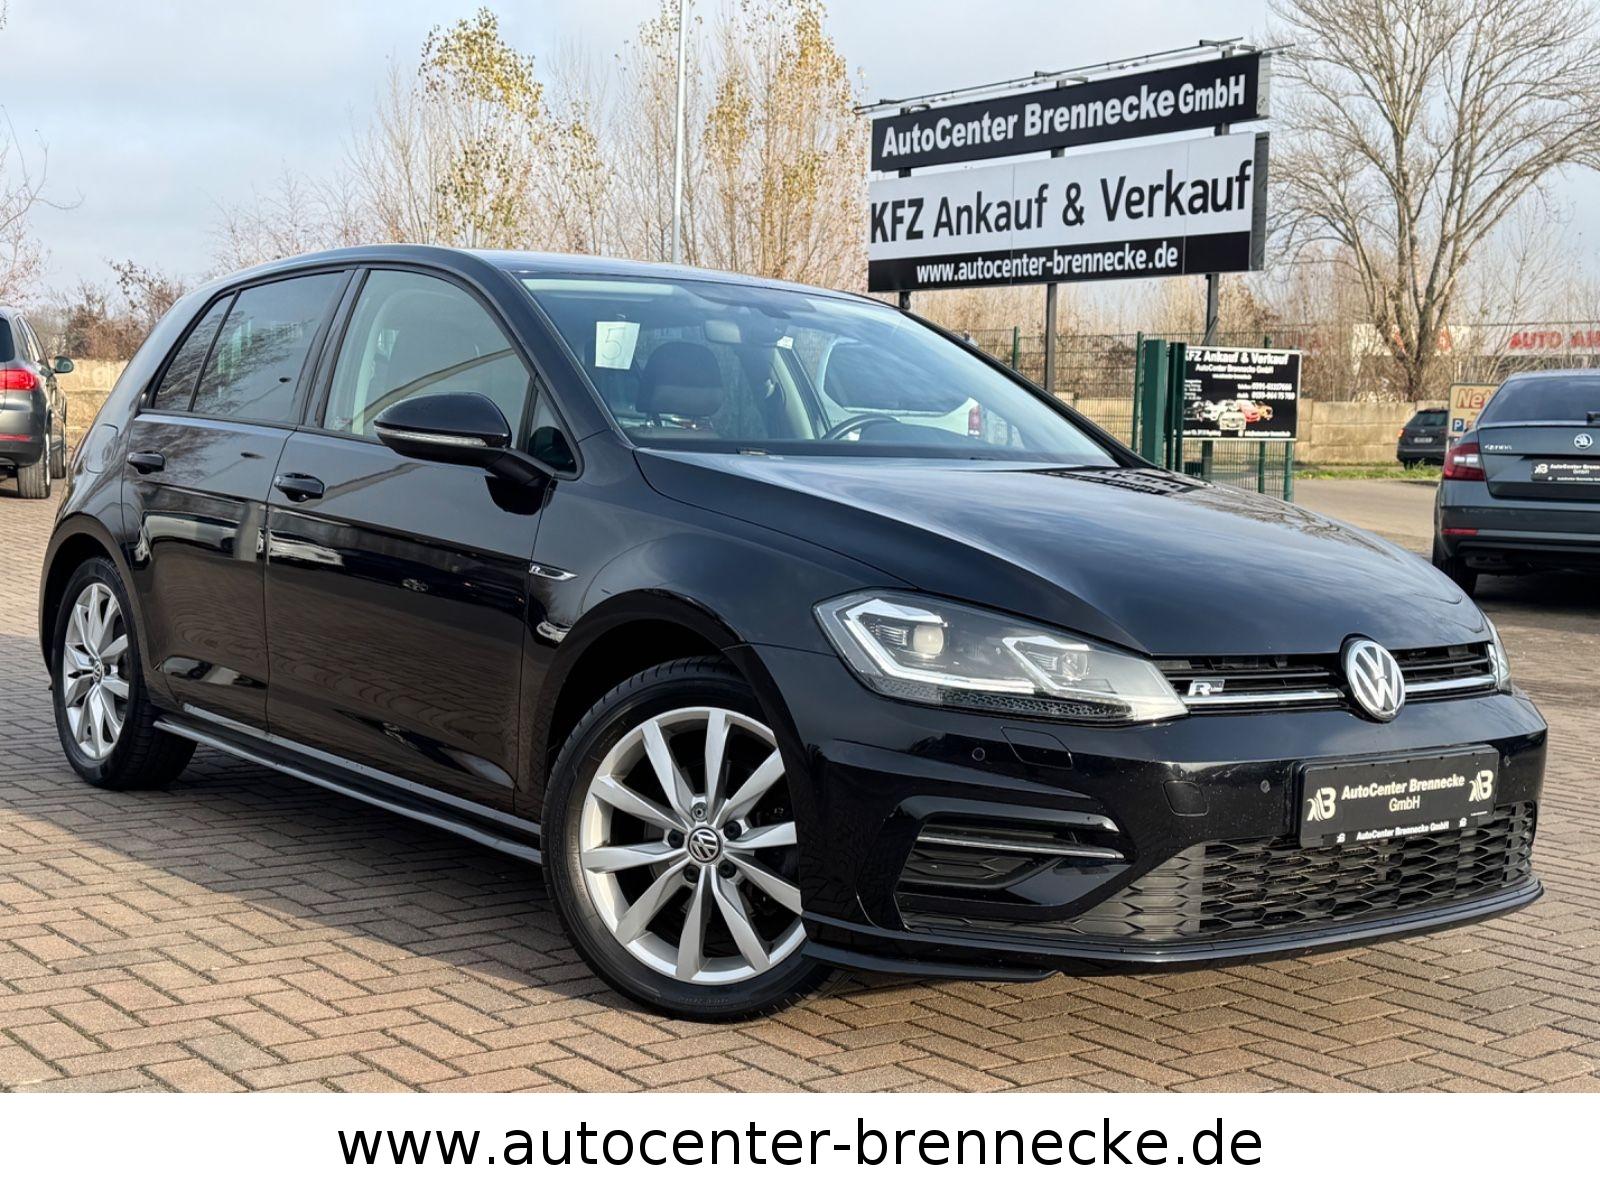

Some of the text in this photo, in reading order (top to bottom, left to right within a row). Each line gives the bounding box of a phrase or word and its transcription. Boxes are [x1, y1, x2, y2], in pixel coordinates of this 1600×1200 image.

[881, 73, 1246, 159] AutoCenter Brennecke GmbH
[871, 159, 1252, 244] KFZ Ankauf & Verkauf
[916, 240, 1178, 284] www.autocenter-brennecke.de
[601, 326, 625, 361] 5
[1509, 331, 1562, 349] AUTO
[1204, 351, 1239, 363] Ankauf
[1241, 352, 1249, 363] &
[1252, 353, 1289, 365] Verkauf
[1341, 781, 1407, 801] AutoCenter
[1409, 773, 1465, 793] Brennecke
[1388, 795, 1420, 812] GmbH
[1356, 827, 1394, 841] AutoCenter
[1395, 824, 1430, 836] Brennecke
[1430, 820, 1449, 831] GmbH
